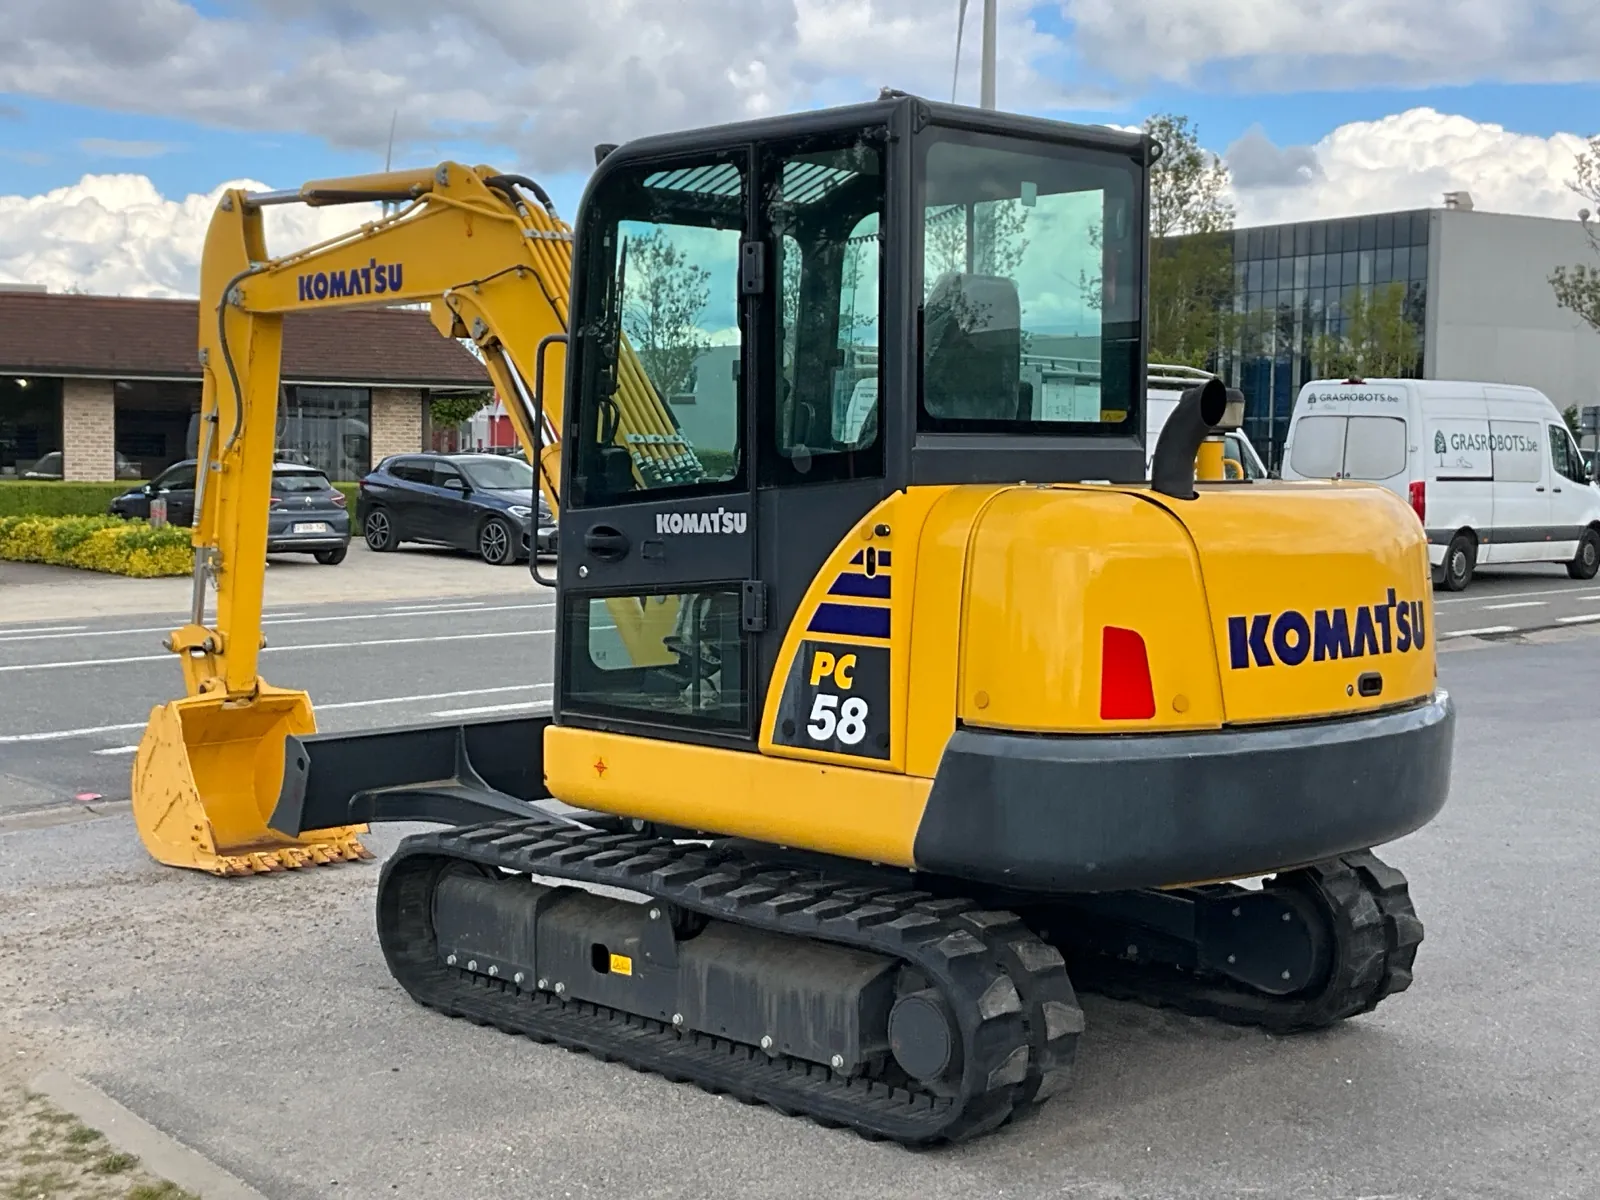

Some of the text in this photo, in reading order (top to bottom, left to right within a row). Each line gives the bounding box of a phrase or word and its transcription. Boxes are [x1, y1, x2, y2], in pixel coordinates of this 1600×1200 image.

[298, 258, 402, 301] KOMATSU
[1319, 393, 1399, 402] GRASROBOTS.be
[1450, 433, 1538, 452] GRASROBOTS.be
[656, 507, 747, 534] KOMATSU
[1228, 588, 1425, 669] KOMATSU
[810, 651, 857, 689] PC
[806, 693, 868, 745] 58
